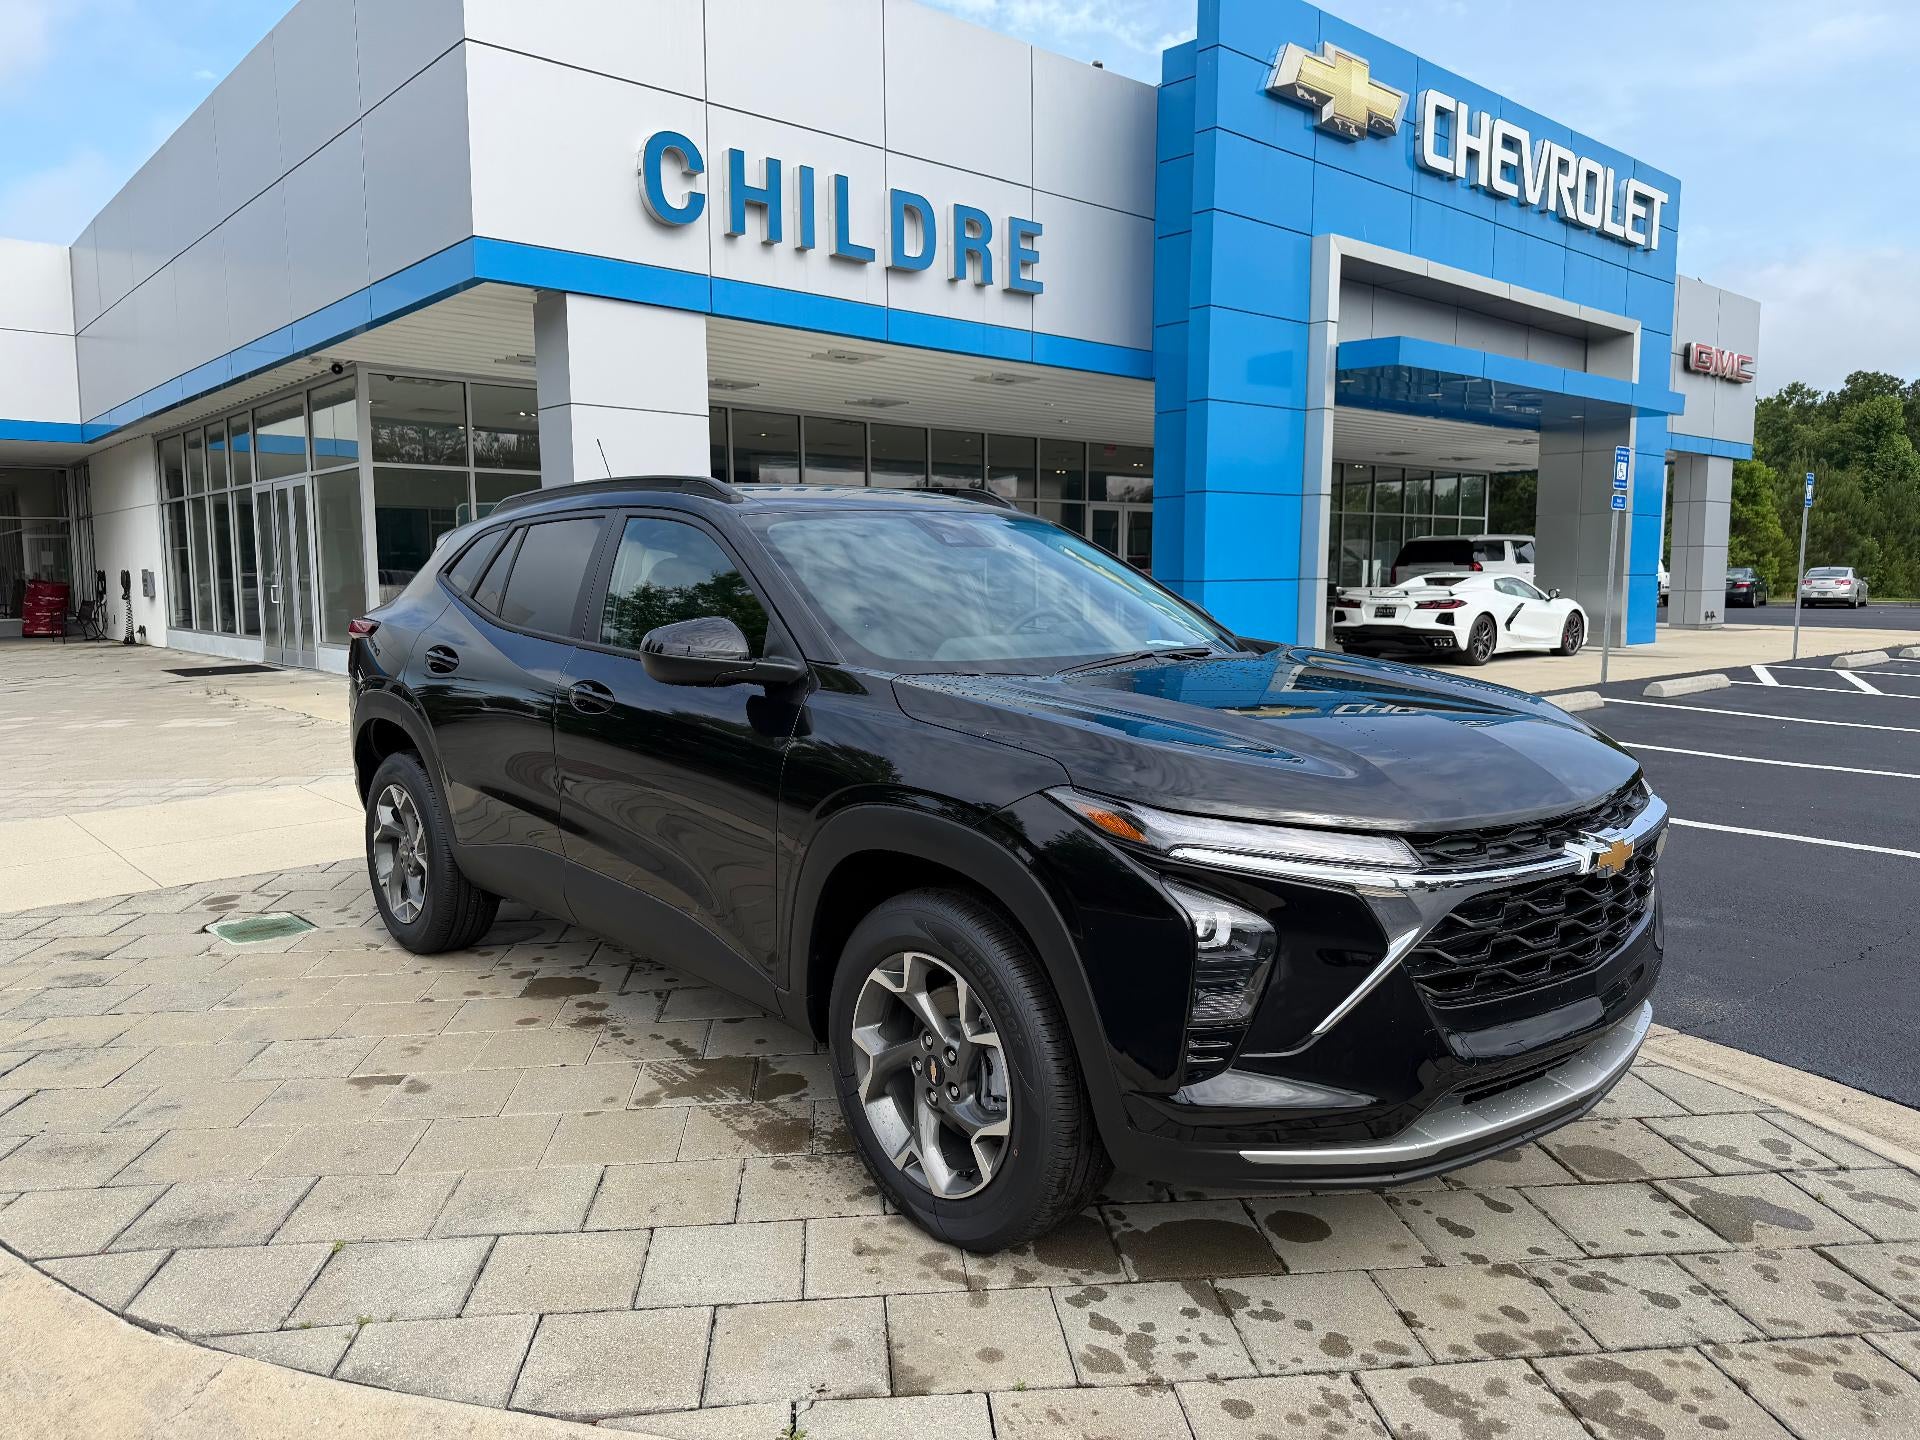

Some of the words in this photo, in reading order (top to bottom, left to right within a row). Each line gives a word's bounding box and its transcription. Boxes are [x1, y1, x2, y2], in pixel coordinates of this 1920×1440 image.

[638, 130, 1044, 295] CHILDRE
[1416, 88, 1668, 251] CHEVROLET
[1689, 342, 1754, 384] GMC
